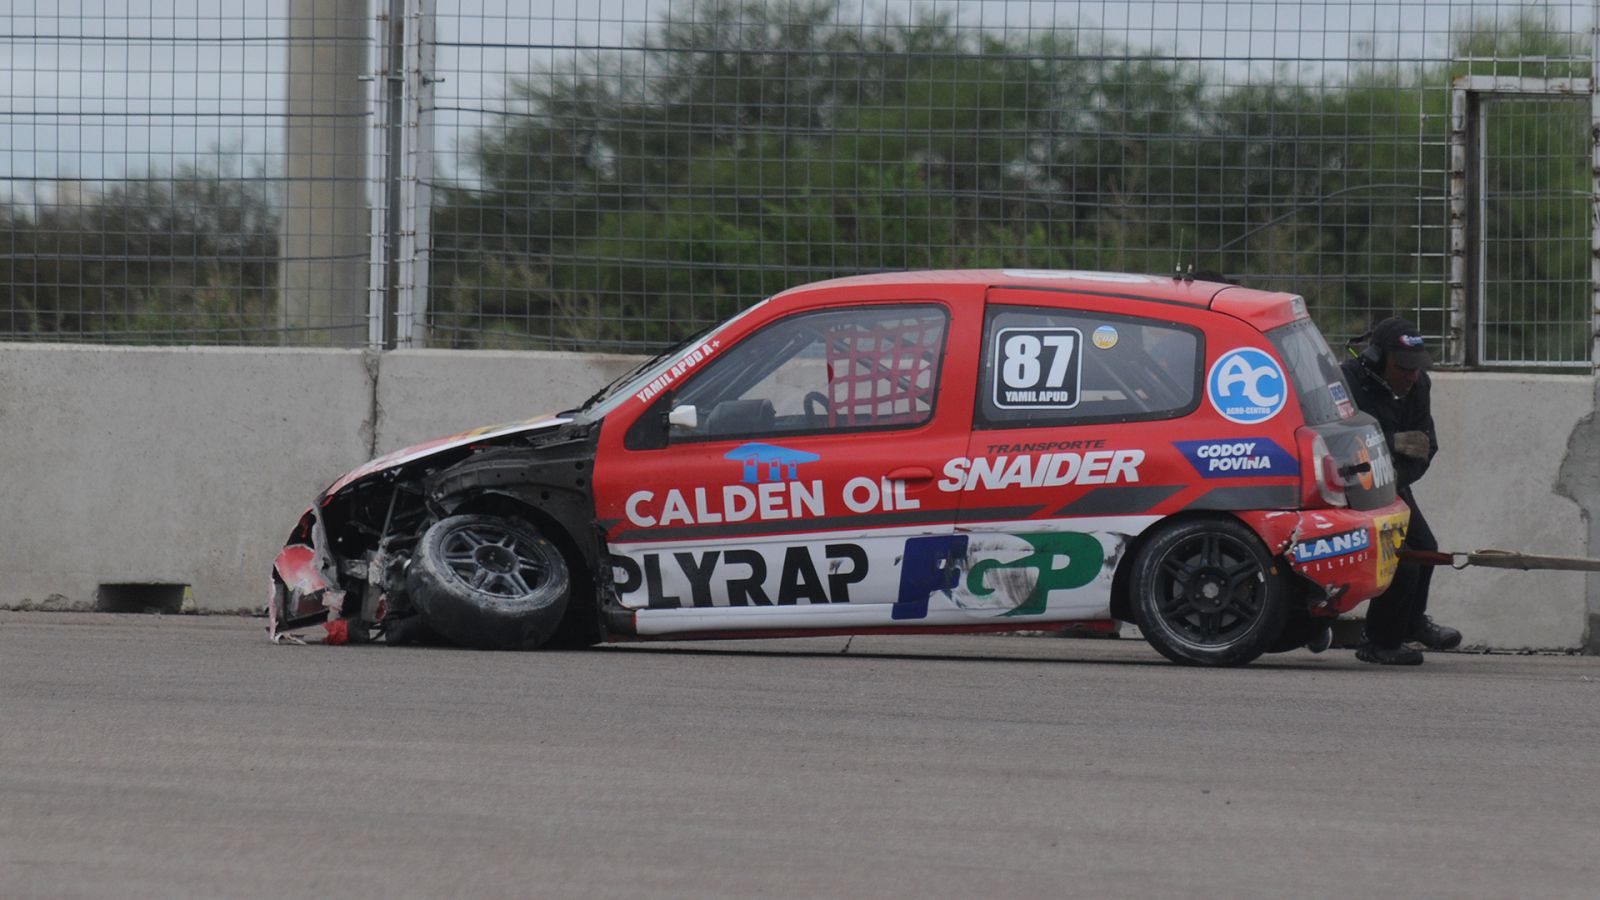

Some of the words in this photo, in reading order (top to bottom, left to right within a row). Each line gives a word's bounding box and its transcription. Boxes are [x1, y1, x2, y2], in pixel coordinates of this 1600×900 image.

[636, 373, 674, 403] YAMIL
[671, 350, 704, 378] APUD
[1003, 335, 1074, 389] 87
[1217, 354, 1280, 407] AC
[1005, 391, 1037, 402] YAMIL
[1039, 391, 1069, 402] APUD
[986, 439, 1107, 454] TRANSPORTE
[1197, 443, 1256, 458] GODOY
[937, 449, 1146, 493] SNAIDER
[625, 480, 825, 527] CALDEN
[842, 476, 920, 513] OIL
[1298, 528, 1369, 559] LANSS
[607, 543, 869, 609] PLYRAP
